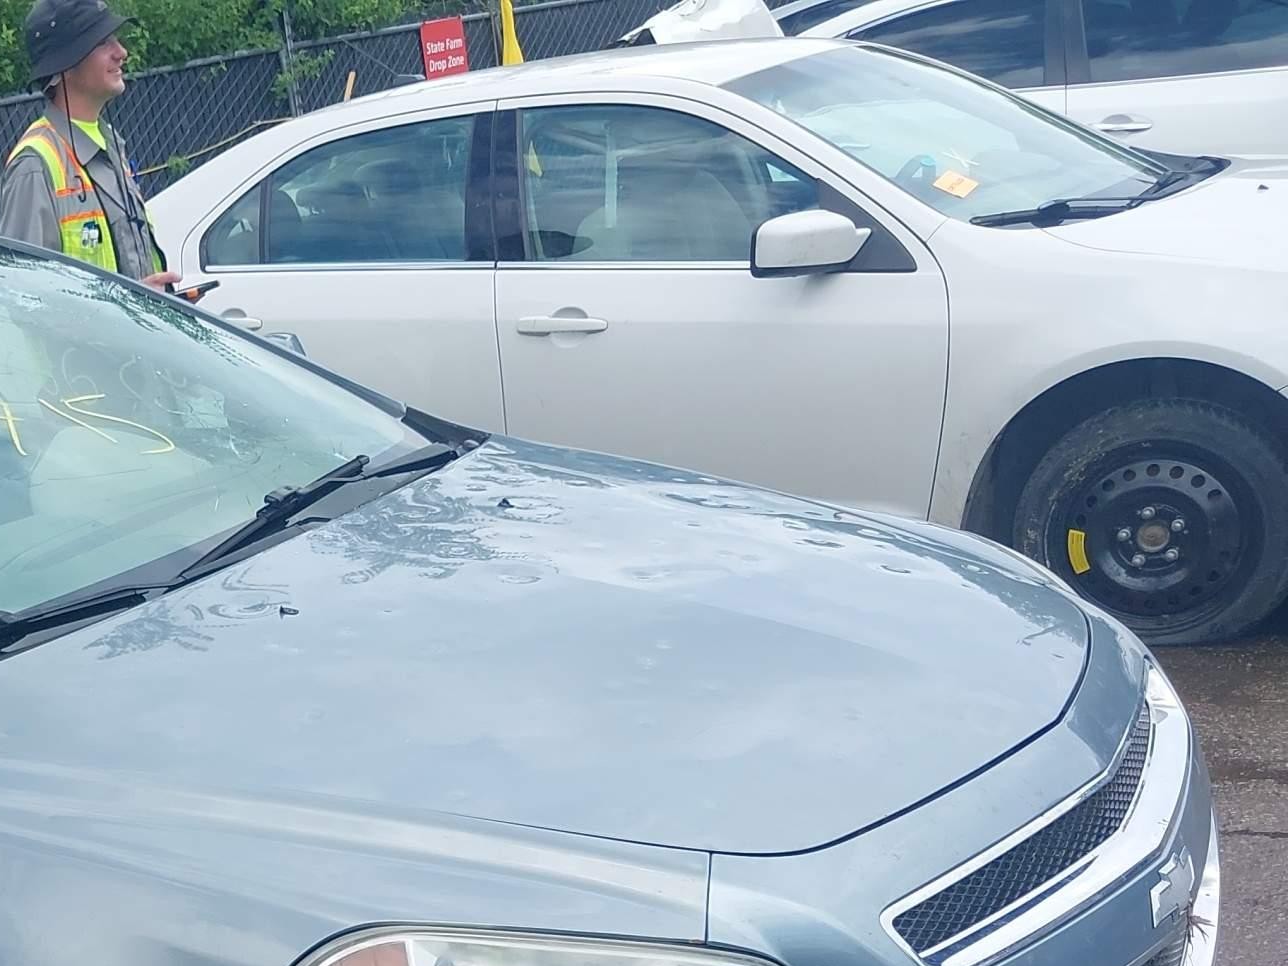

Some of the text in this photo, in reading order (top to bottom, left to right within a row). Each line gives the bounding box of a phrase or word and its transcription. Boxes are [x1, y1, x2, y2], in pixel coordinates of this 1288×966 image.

[426, 38, 463, 55] State Farm
[429, 55, 464, 72] Drop Zone
